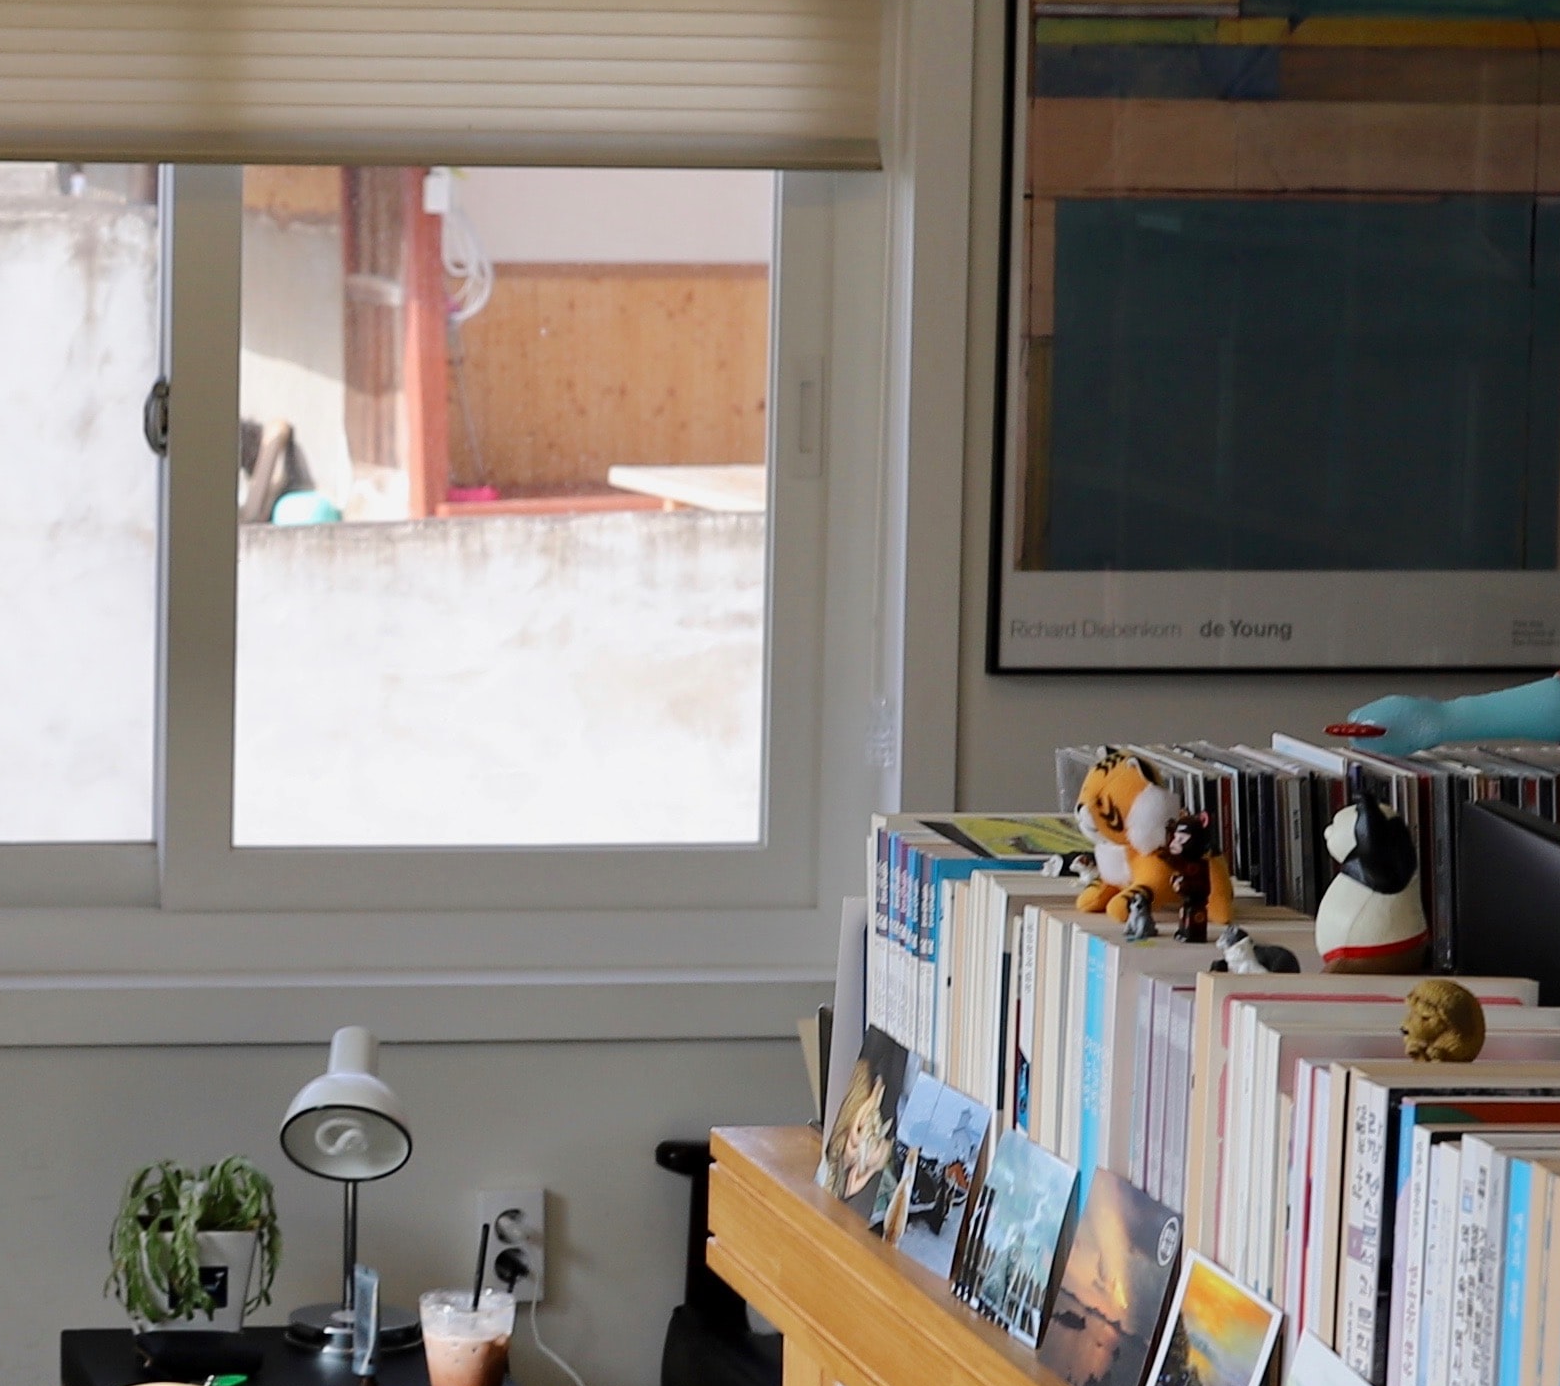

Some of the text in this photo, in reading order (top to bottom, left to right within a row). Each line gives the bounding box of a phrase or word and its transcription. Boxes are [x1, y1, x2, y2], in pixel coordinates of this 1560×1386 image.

[1010, 619, 1294, 642] Richard Diebenkorn de Young
